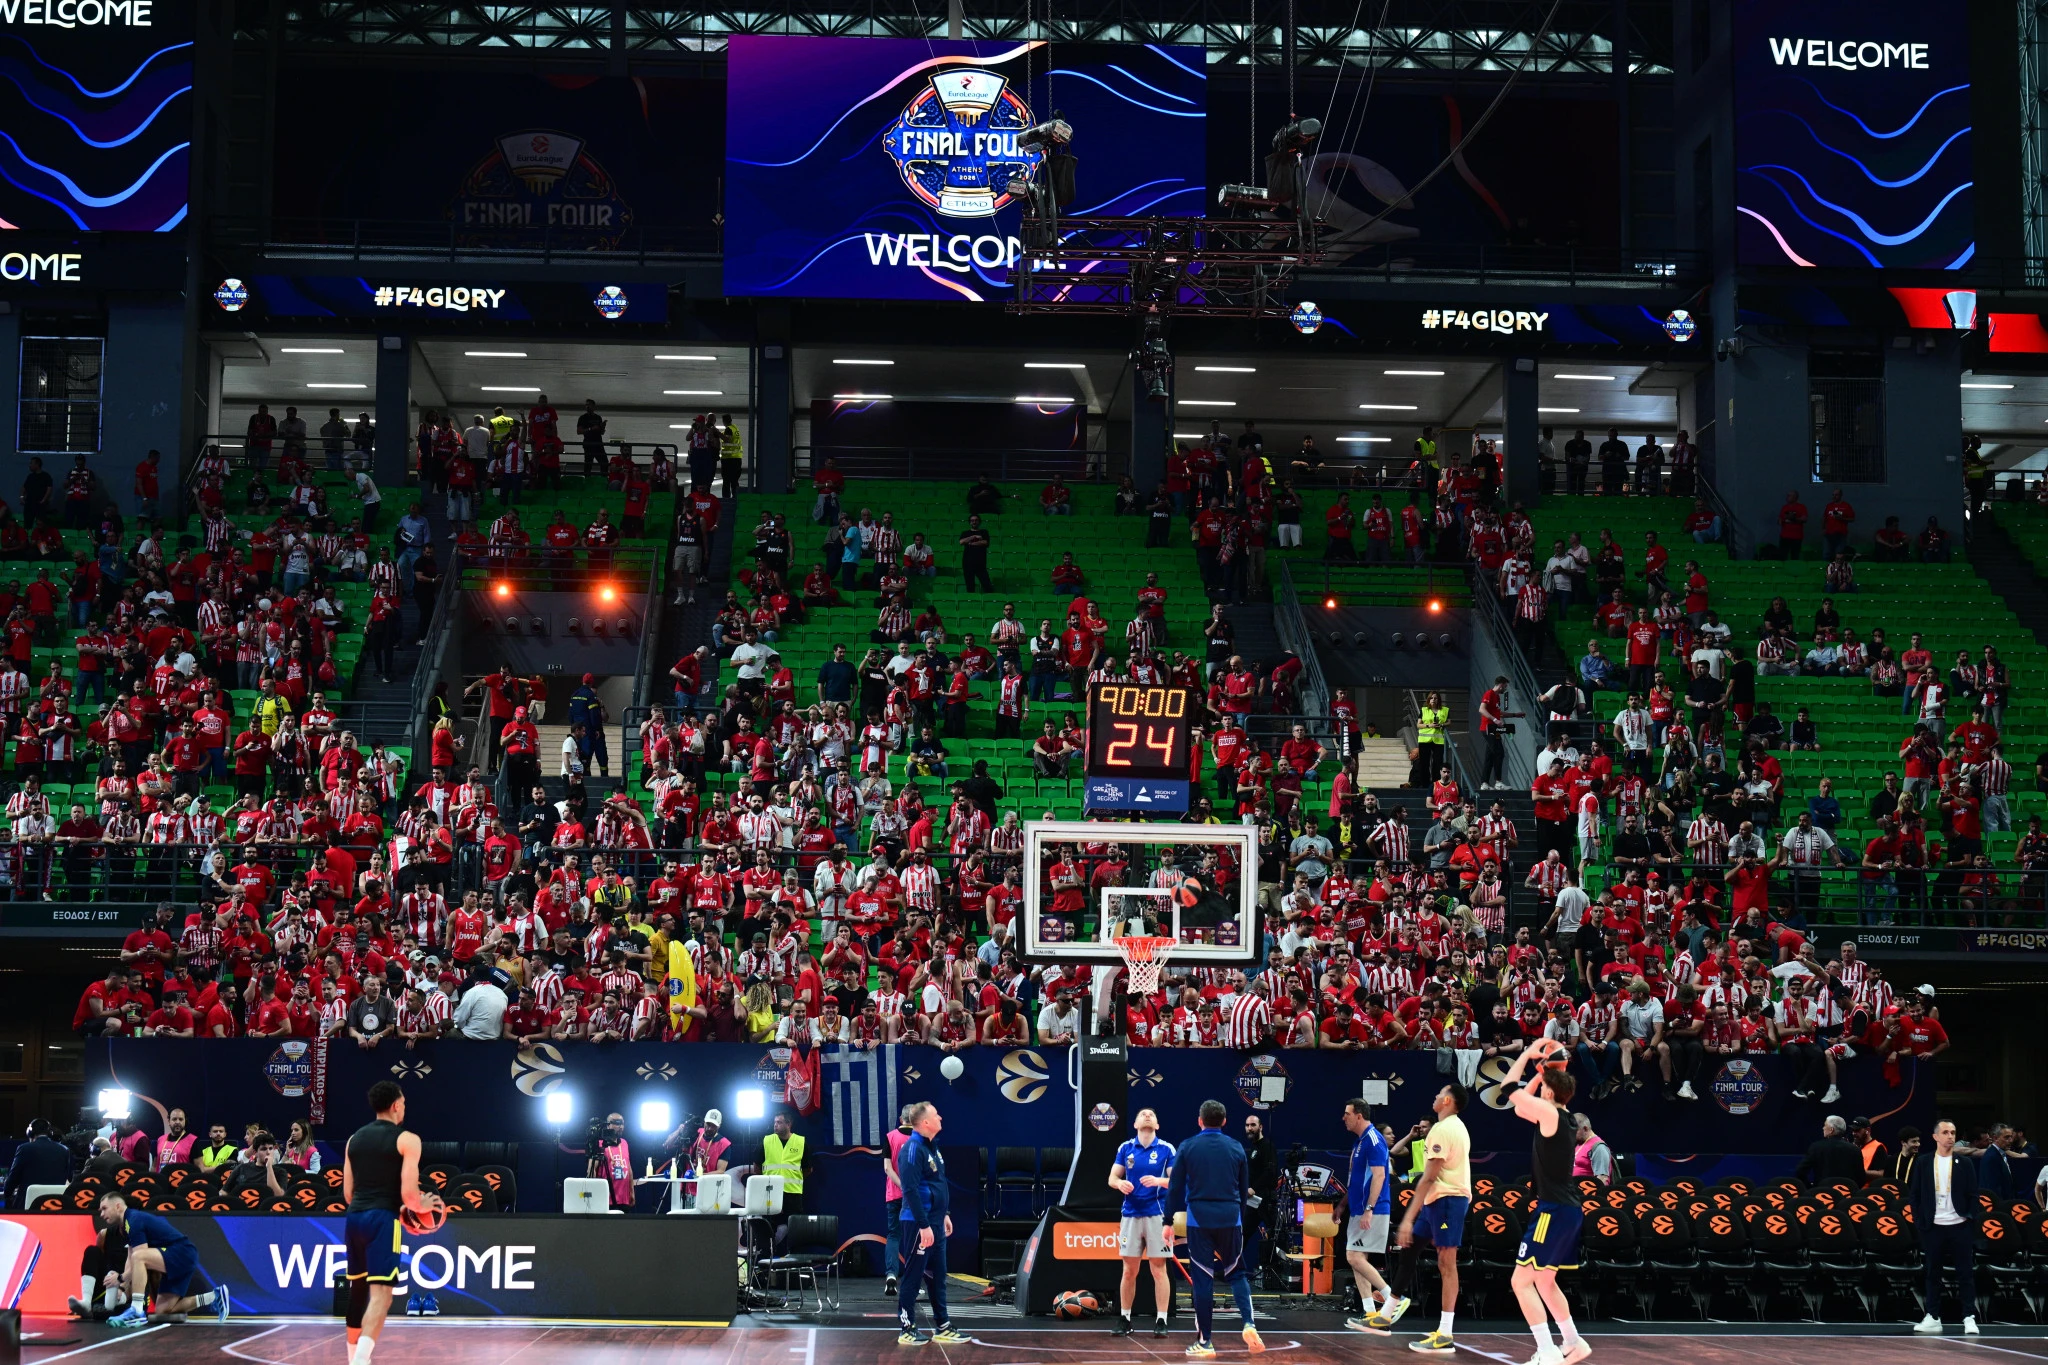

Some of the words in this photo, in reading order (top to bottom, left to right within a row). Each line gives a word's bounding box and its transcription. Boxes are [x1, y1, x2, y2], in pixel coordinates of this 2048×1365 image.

[0, 0, 152, 28] WELCOME
[1769, 37, 1929, 70] WELCOME
[948, 91, 989, 99] EuroLeague
[946, 200, 988, 208] ETIHAD
[374, 286, 506, 311] #F4GLORY
[1421, 309, 1549, 334] #F4GLORY
[155, 676, 168, 695] 17
[1100, 686, 1187, 718] 90:00
[1106, 723, 1175, 767] 24
[703, 887, 713, 896] 14
[912, 890, 931, 898] bwin
[962, 890, 982, 898] bwin
[697, 898, 718, 906] bwin
[53, 911, 90, 920] ΕΞΟΔΟΣ
[91, 911, 97, 921] /
[98, 911, 119, 920] EXIT
[465, 921, 474, 930] 15
[1423, 926, 1431, 934] 16
[458, 932, 479, 940] bwin
[1857, 934, 1893, 944] ΕΞΟΔΟΣ
[1894, 935, 1899, 945] /
[1900, 935, 1920, 944] EXIT
[1520, 987, 1528, 995] 14
[1089, 1047, 1120, 1055] SPALDING
[296, 1064, 312, 1074] FOU
[317, 1036, 328, 1096] LYMPIAKOS
[1741, 1082, 1763, 1092] FOUR
[269, 1243, 536, 1296] WEOME
